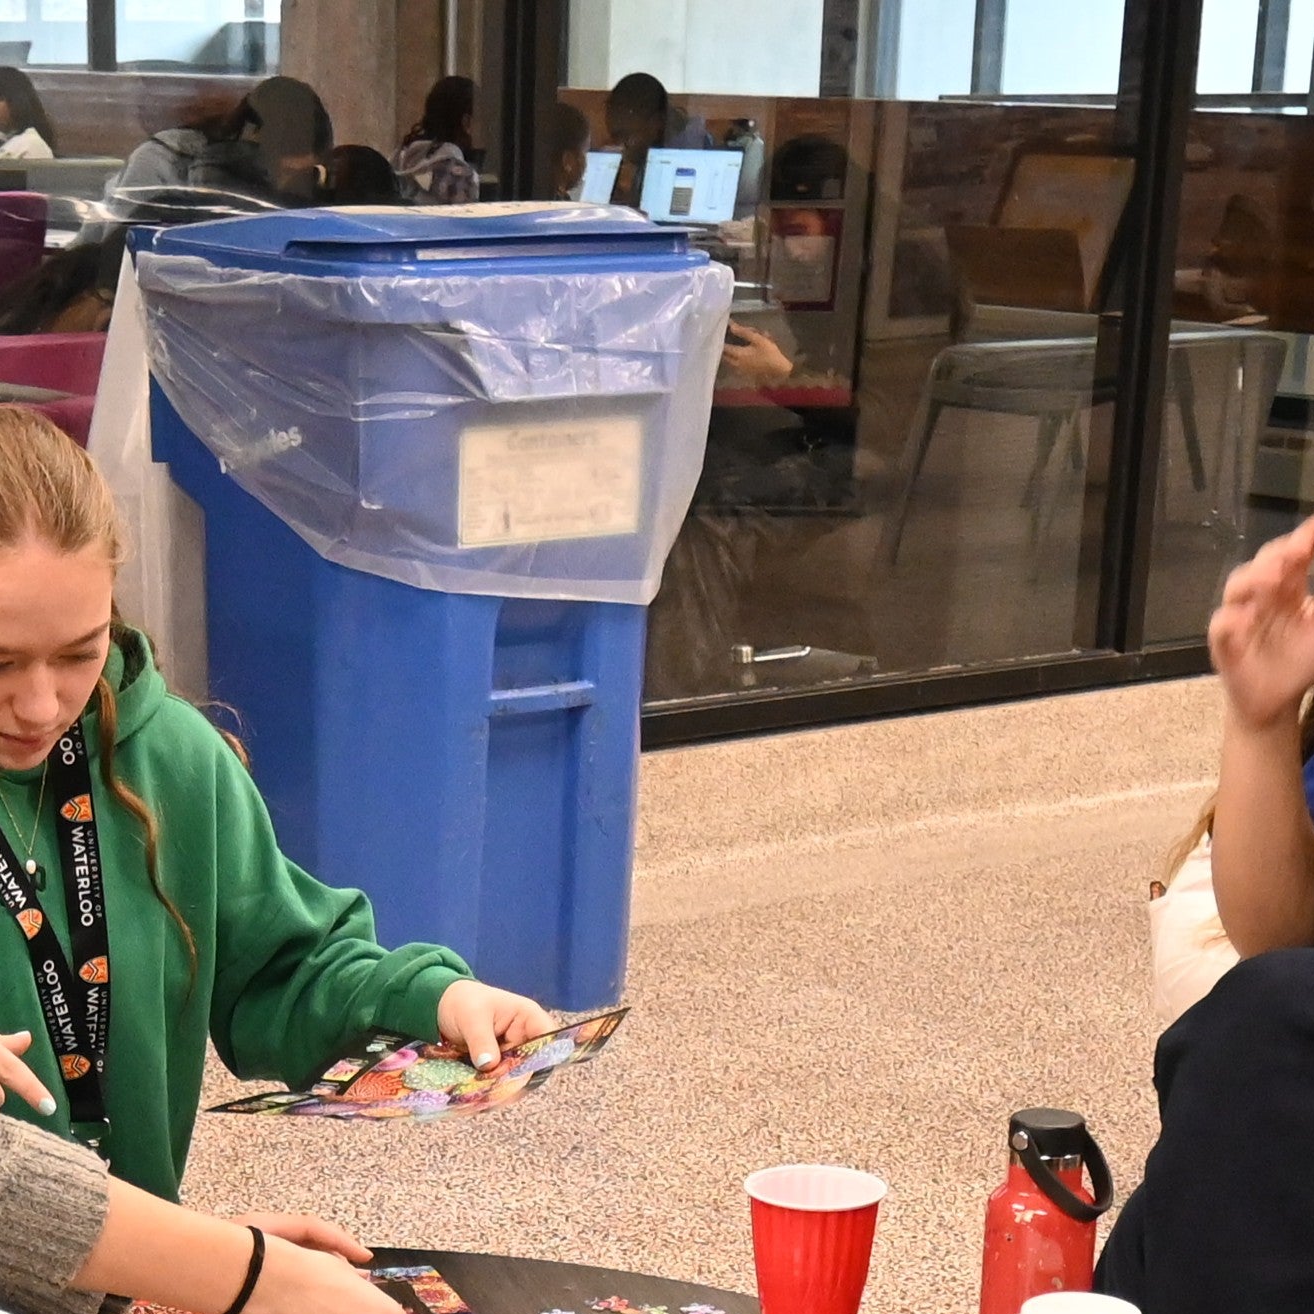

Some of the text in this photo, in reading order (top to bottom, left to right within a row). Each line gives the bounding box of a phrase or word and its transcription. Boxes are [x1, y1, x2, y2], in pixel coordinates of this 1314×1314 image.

[71, 825, 94, 927] WATERLOO
[87, 830, 103, 918] UNIVERSITY OF
[43, 960, 78, 1052] WATERLOO
[96, 1060, 104, 1074] OF
